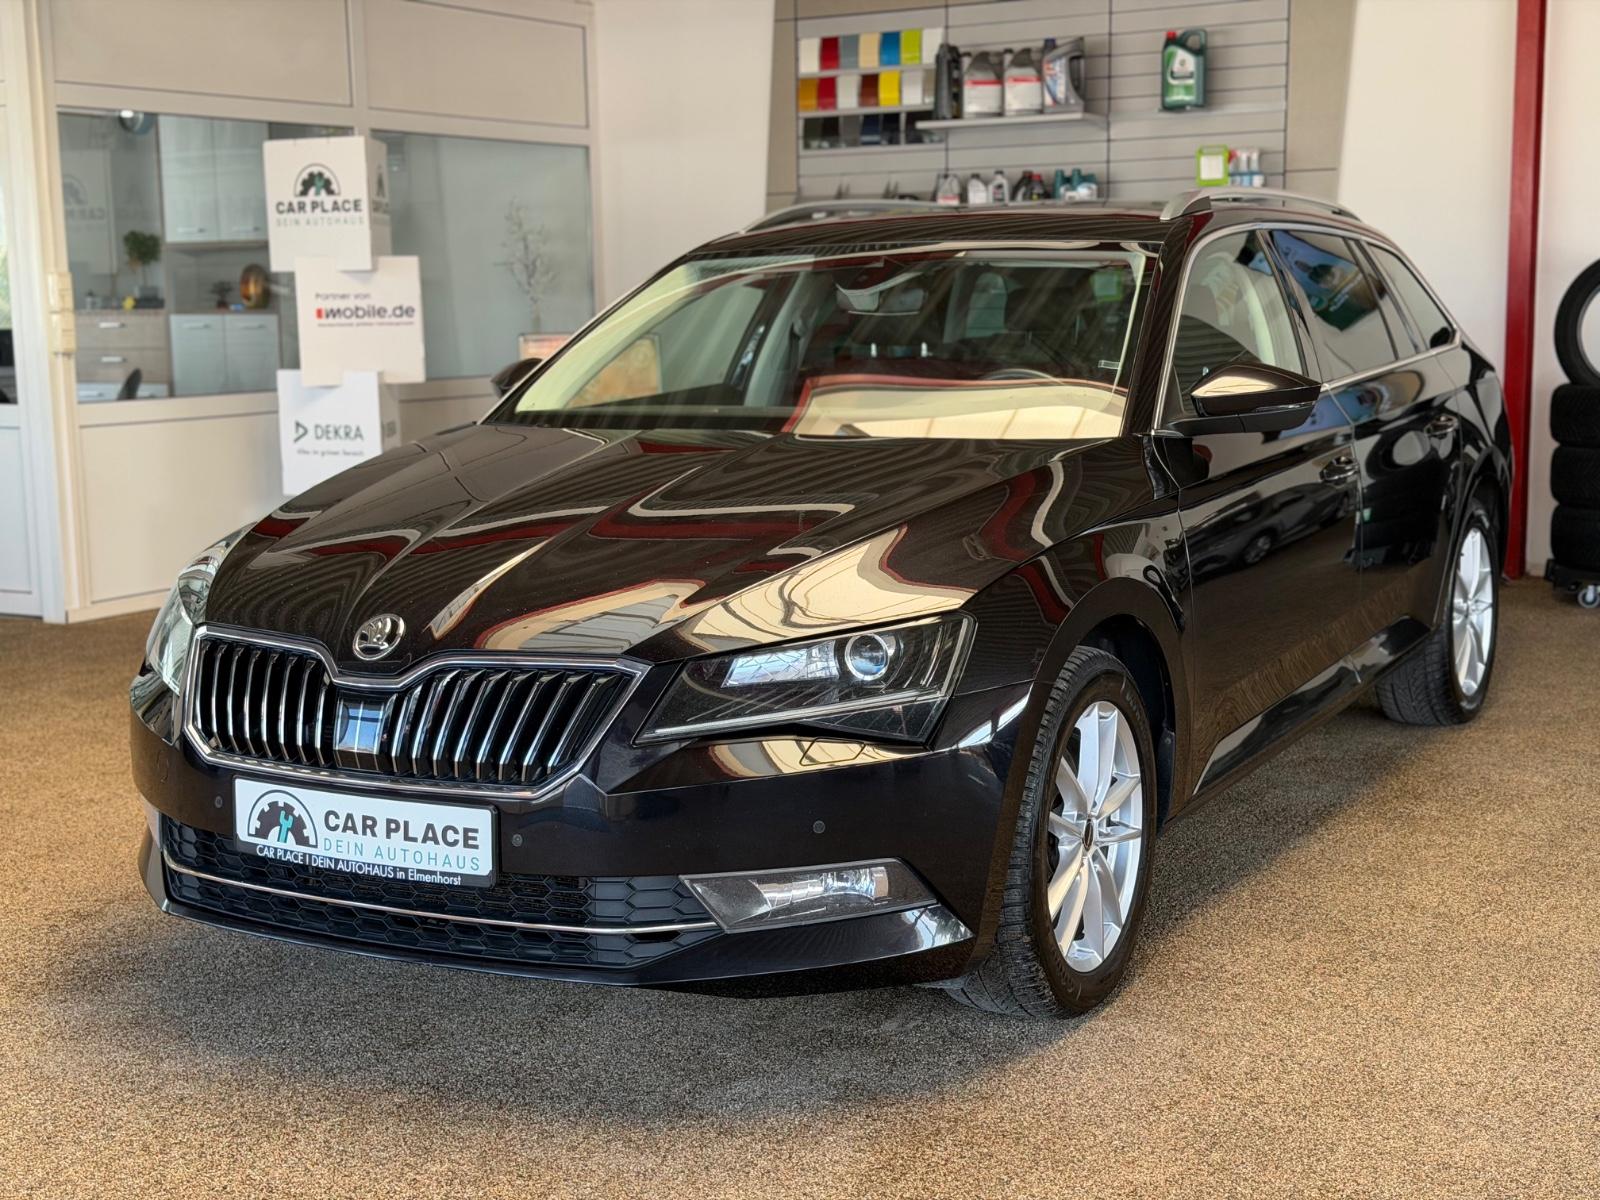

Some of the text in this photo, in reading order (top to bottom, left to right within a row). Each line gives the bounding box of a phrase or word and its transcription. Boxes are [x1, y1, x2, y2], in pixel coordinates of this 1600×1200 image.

[275, 201, 306, 214] CAR
[311, 200, 363, 213] PLACE
[325, 304, 415, 319] mobile.de
[314, 424, 364, 440] DEKRA
[323, 809, 480, 850] CAR PLACE
[256, 844, 275, 859] CAR
[276, 848, 304, 865] PLACE
[311, 855, 335, 870] DEIN
[336, 859, 394, 878] AUTOHAUS
[396, 868, 406, 880] in
[408, 868, 462, 886] Elmenhorst
[323, 837, 480, 871] DEIN AUTOHAUS
